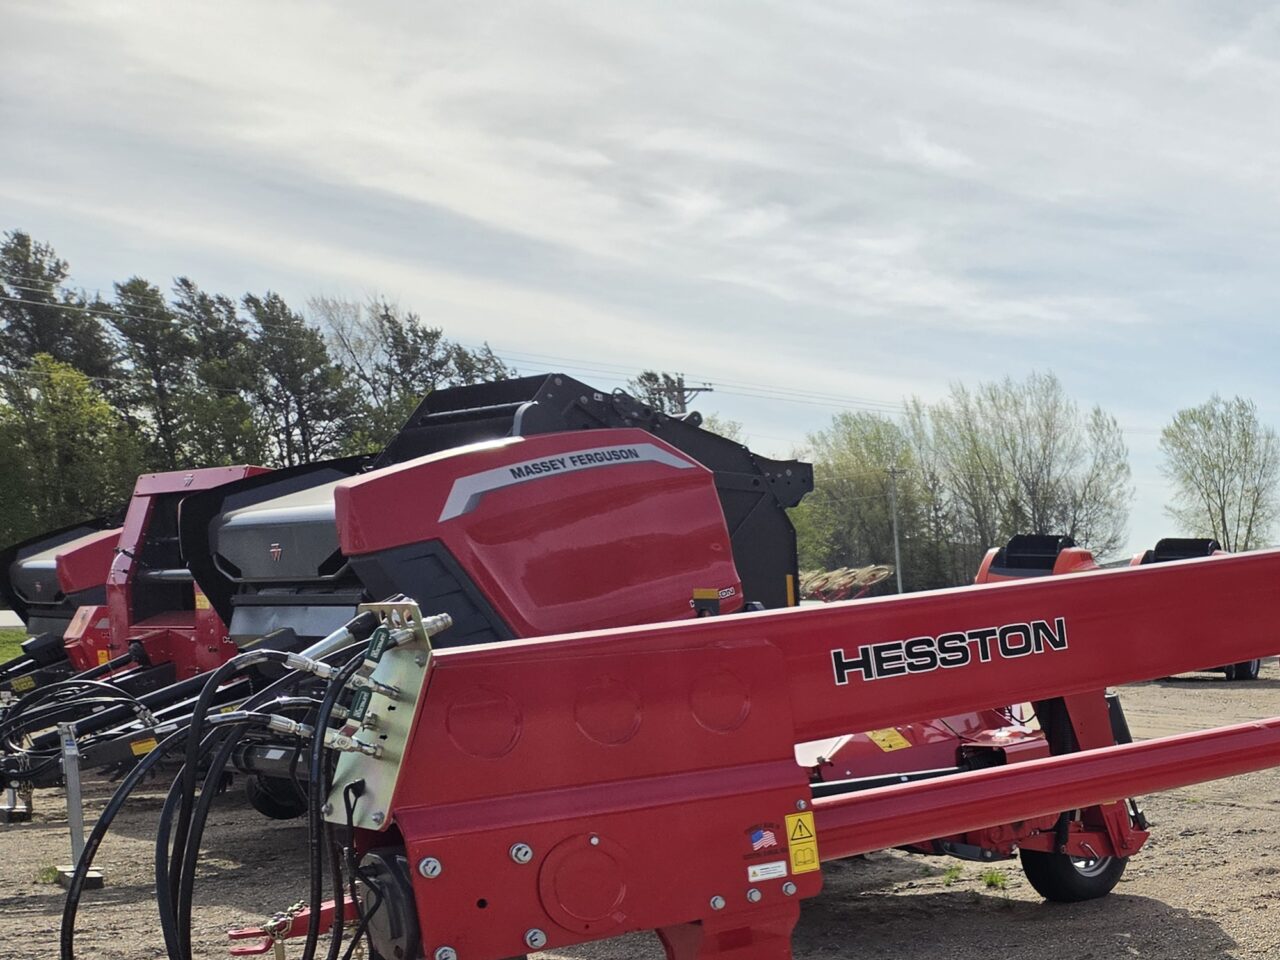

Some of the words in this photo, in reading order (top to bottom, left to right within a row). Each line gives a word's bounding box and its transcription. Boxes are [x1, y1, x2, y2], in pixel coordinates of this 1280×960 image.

[509, 458, 570, 479] MASSEY
[569, 448, 640, 467] FERGUSON
[831, 617, 1067, 685] HESSTON
